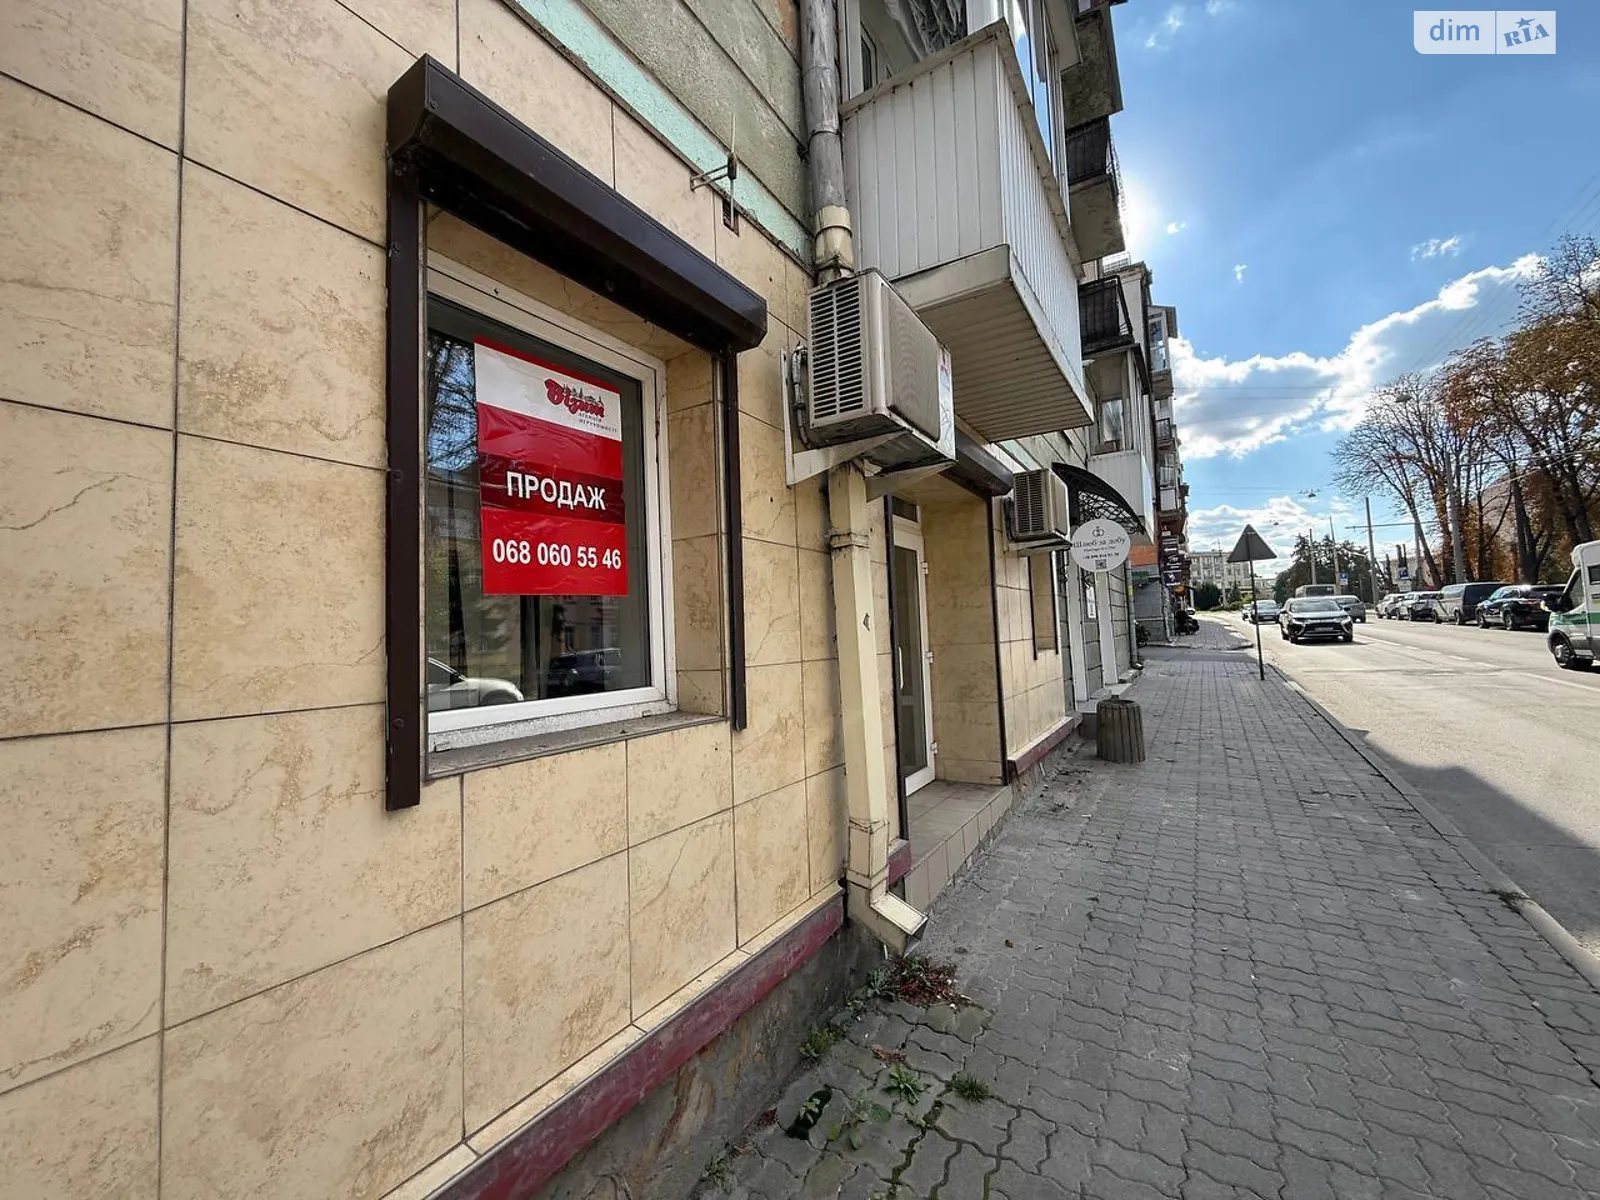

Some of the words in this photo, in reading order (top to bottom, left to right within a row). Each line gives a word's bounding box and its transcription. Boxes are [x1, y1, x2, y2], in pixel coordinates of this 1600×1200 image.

[506, 470, 606, 511] ПРОДАЖ
[492, 538, 531, 564] 068
[537, 542, 571, 567] 060
[577, 545, 598, 569] 55
[602, 548, 621, 570] 46
